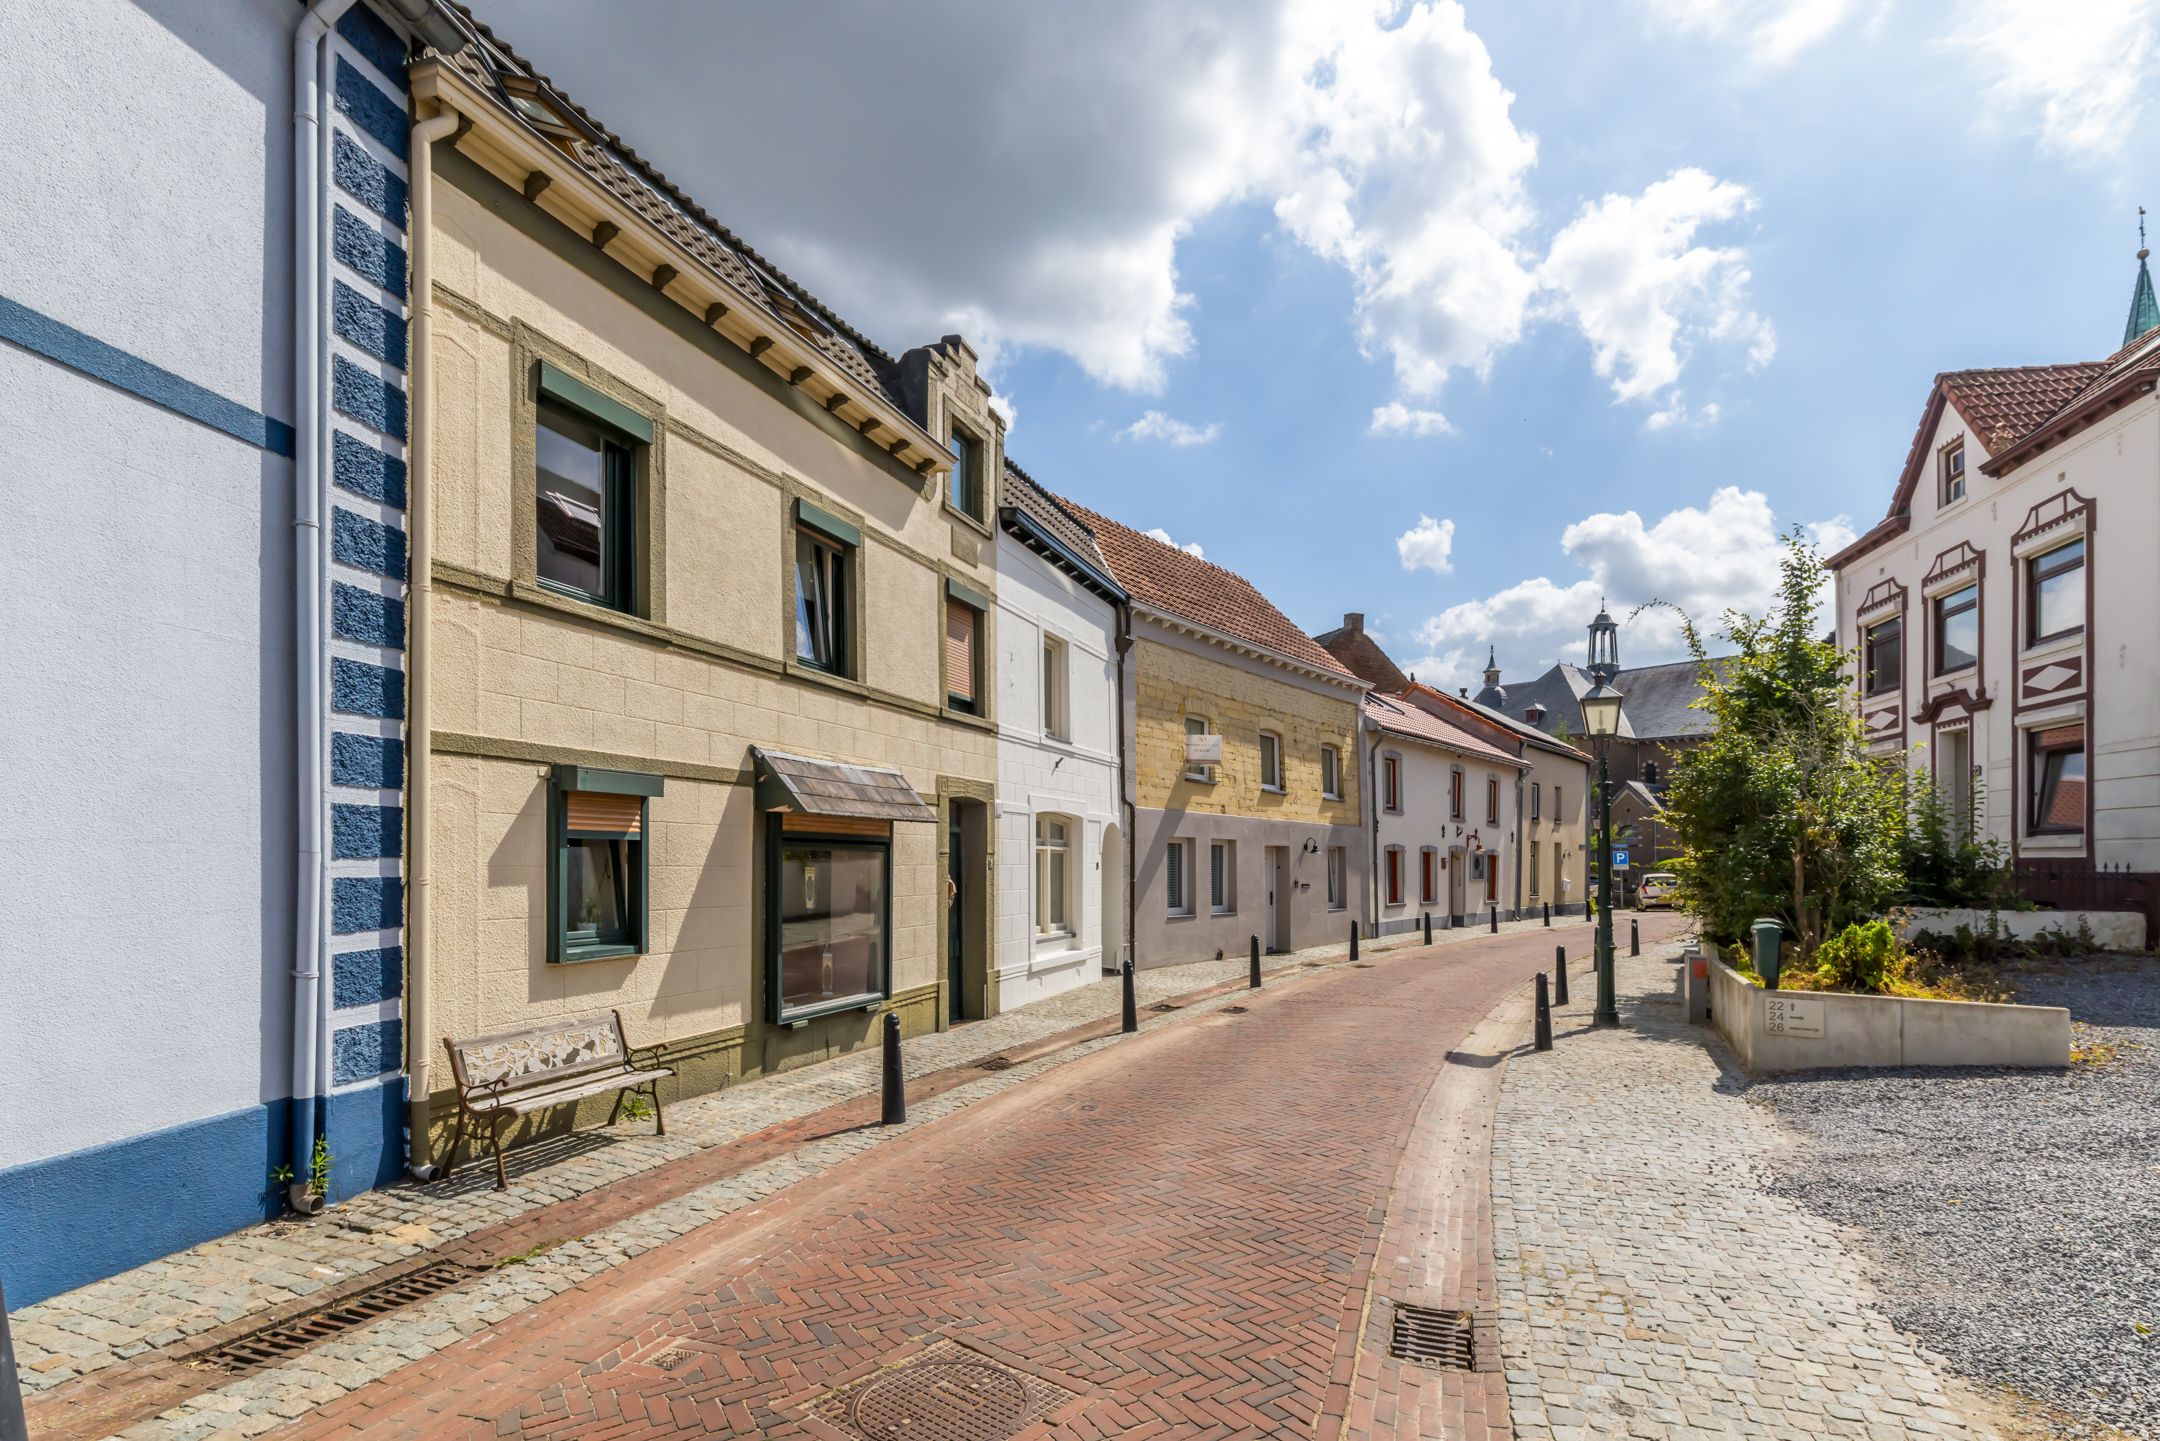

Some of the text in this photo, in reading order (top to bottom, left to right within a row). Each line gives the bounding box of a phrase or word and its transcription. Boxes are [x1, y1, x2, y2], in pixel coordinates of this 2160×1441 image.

[1616, 853, 1625, 863] P
[1769, 1001, 1784, 1011] 22
[1769, 1011, 1784, 1021] 24
[1769, 1022, 1784, 1032] 26
